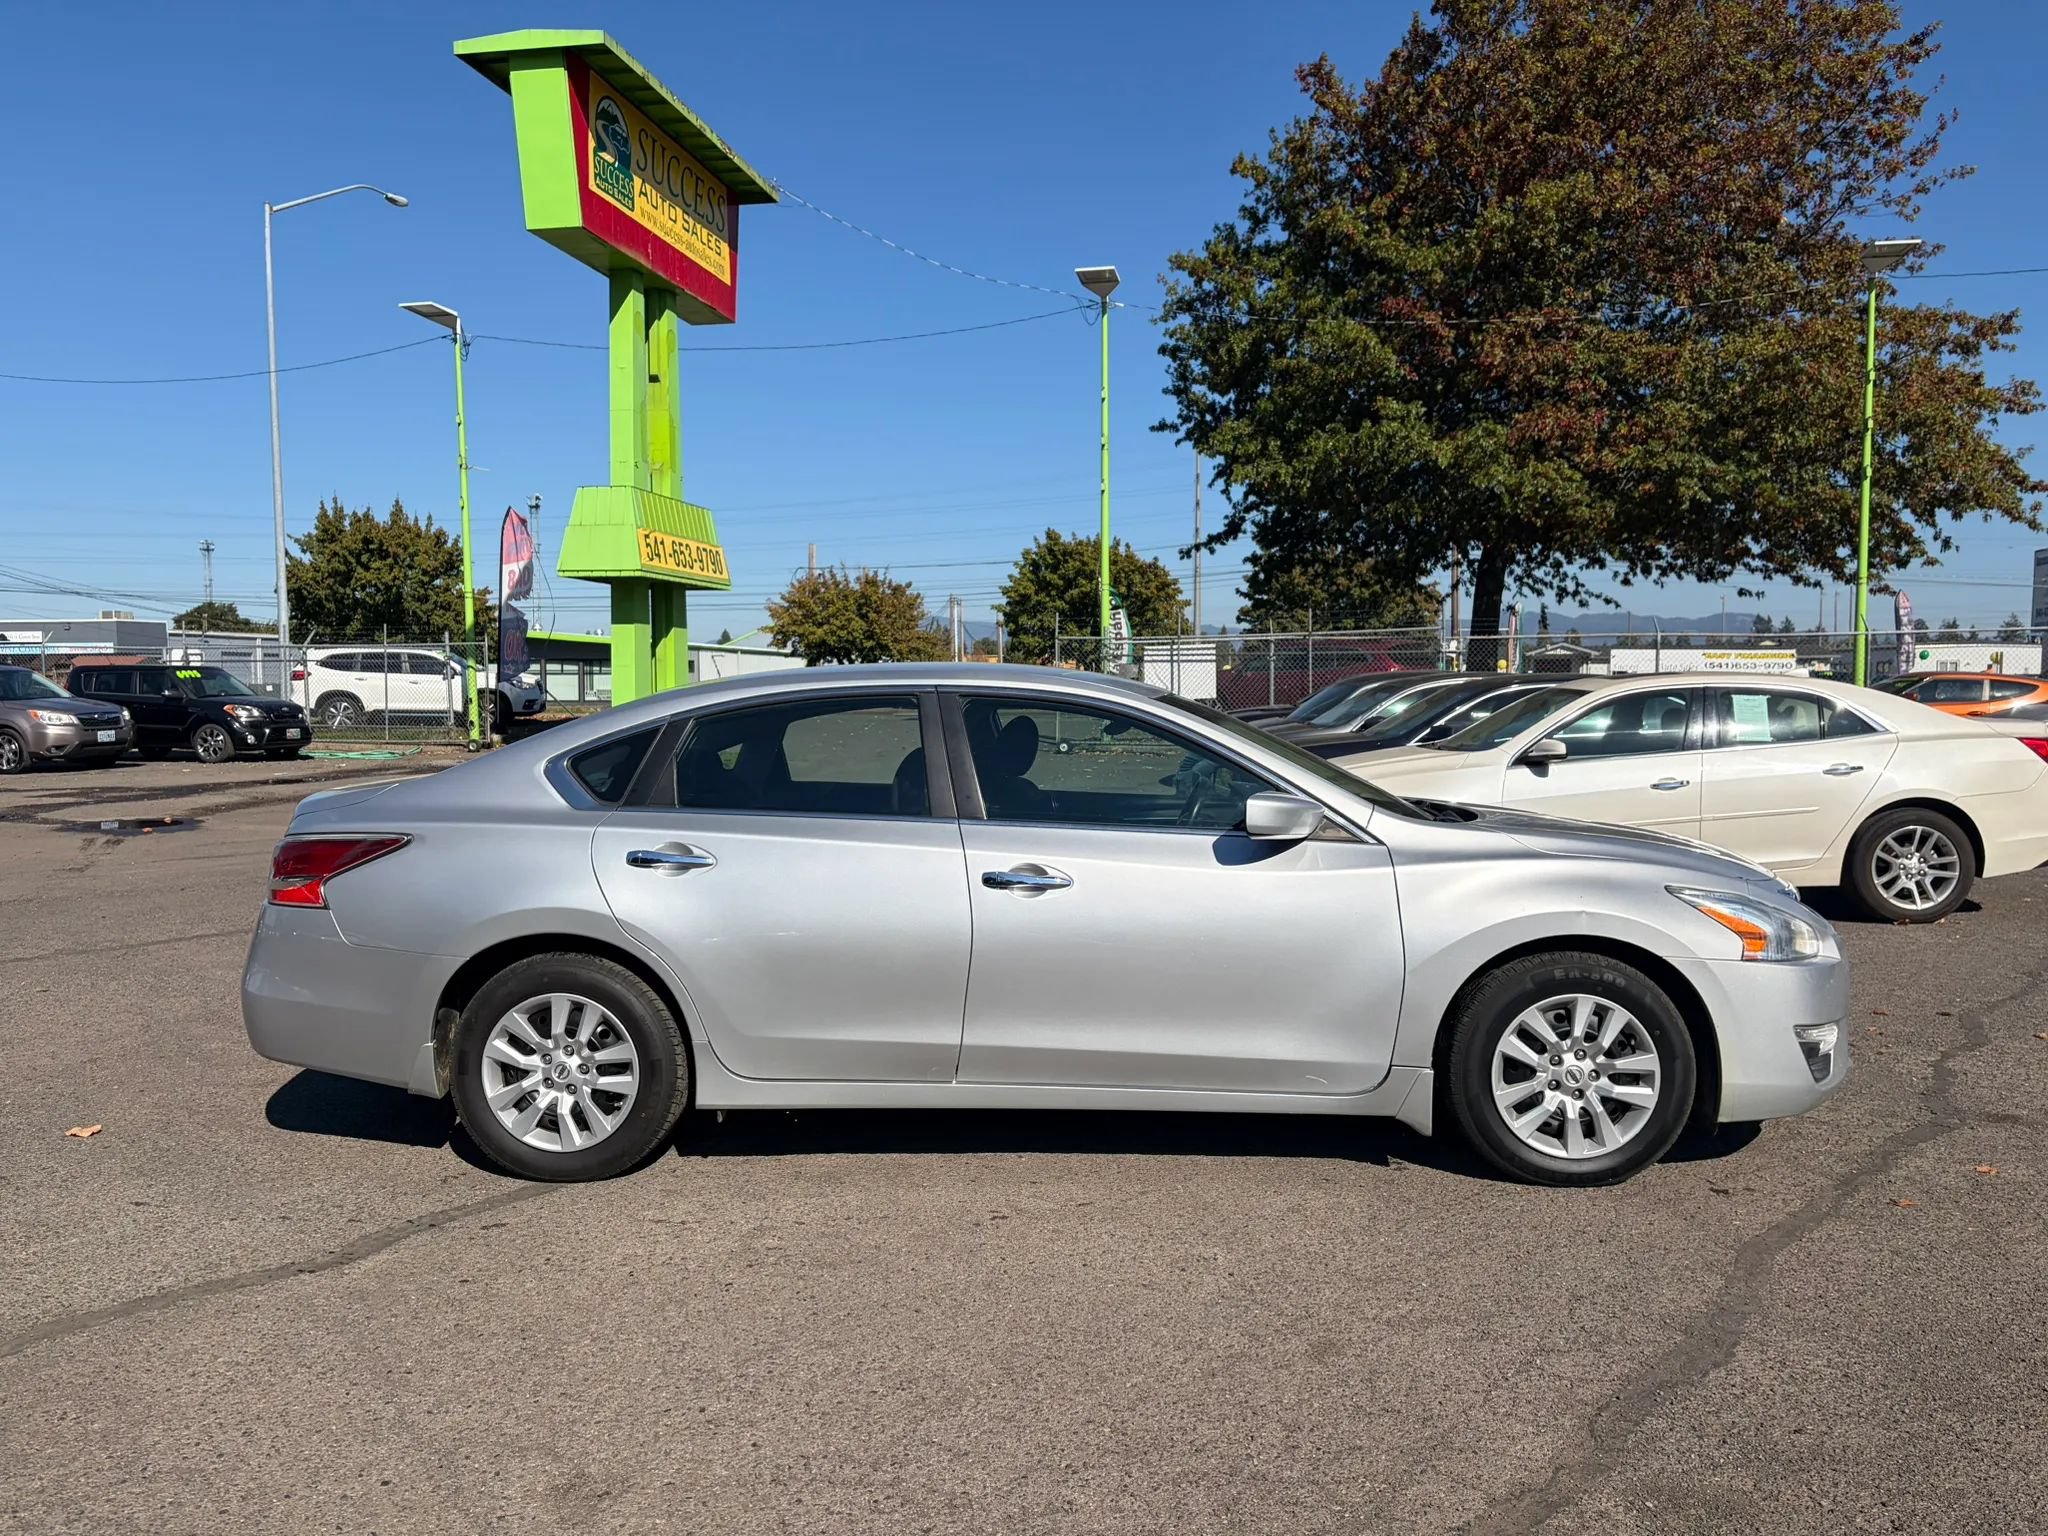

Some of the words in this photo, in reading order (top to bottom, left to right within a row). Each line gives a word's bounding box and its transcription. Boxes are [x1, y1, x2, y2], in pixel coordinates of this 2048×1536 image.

[594, 156, 634, 198] SUCCESS
[596, 176, 613, 195] AUTO
[614, 188, 633, 210] SALES
[636, 127, 727, 234] SUCCESS
[638, 179, 677, 223] AUTO
[682, 210, 722, 257] SALES
[643, 533, 723, 575] 541-653-9790
[1704, 661, 1794, 670] (541)653-9790
